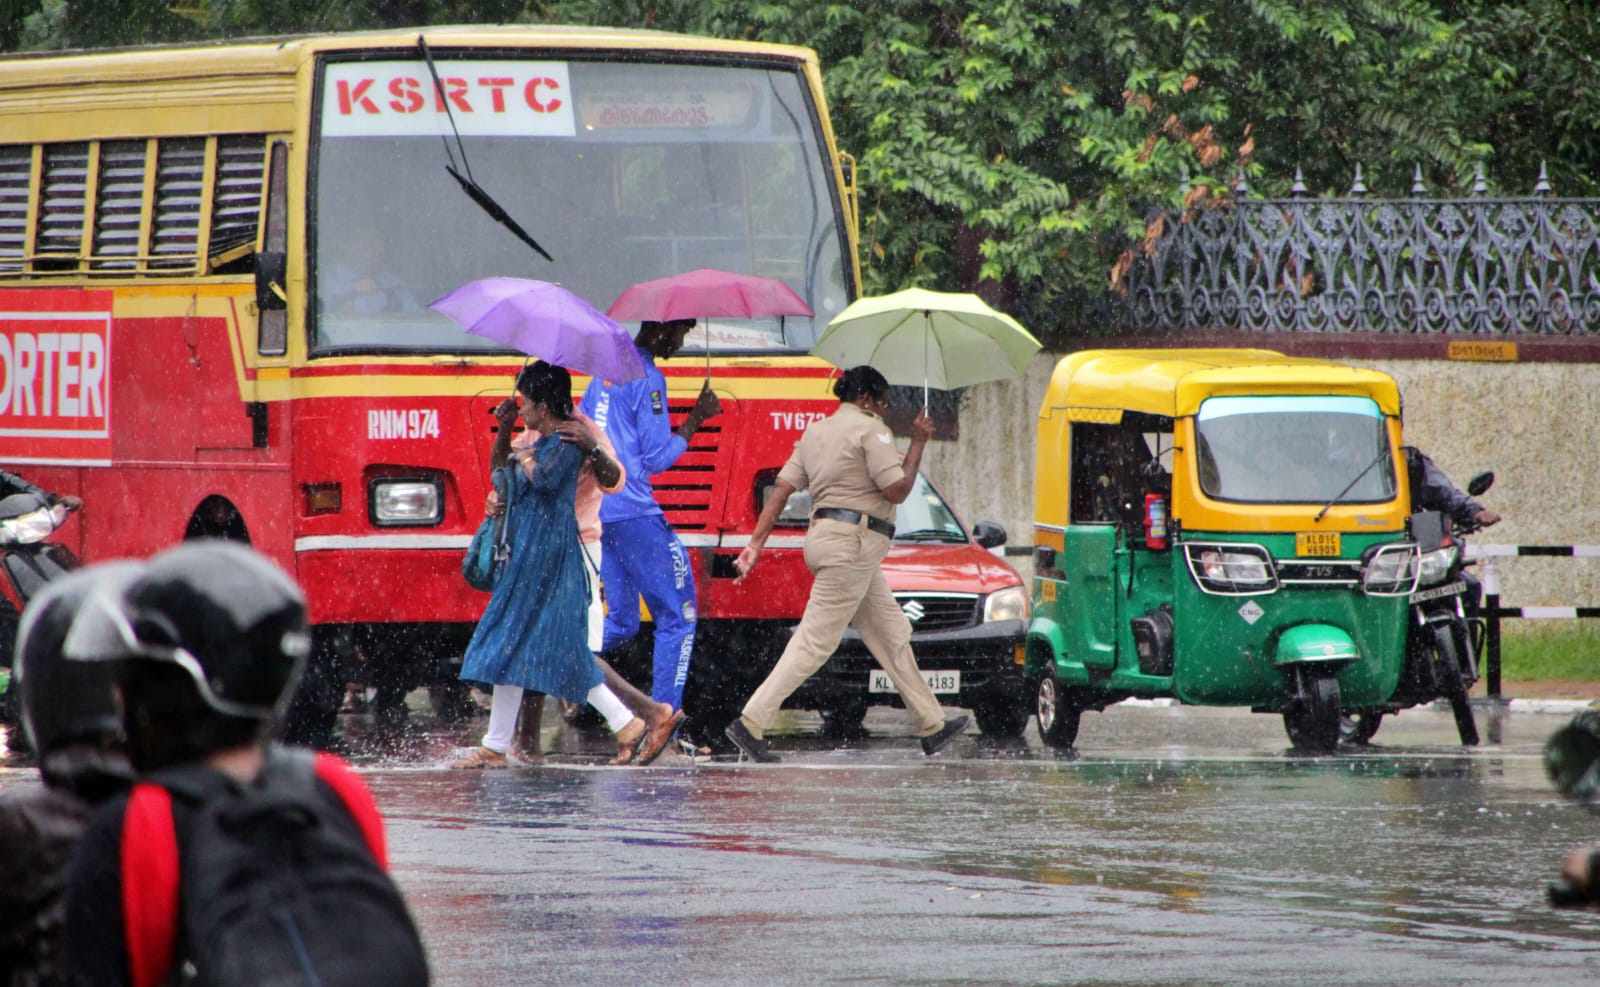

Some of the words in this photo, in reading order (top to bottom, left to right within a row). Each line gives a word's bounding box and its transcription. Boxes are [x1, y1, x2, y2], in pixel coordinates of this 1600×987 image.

[336, 77, 562, 115] KSRTC
[1306, 566, 1333, 577] TVS
[1241, 608, 1260, 616] CNG
[674, 633, 694, 688] BASKETBALL
[927, 674, 955, 689] 4183
